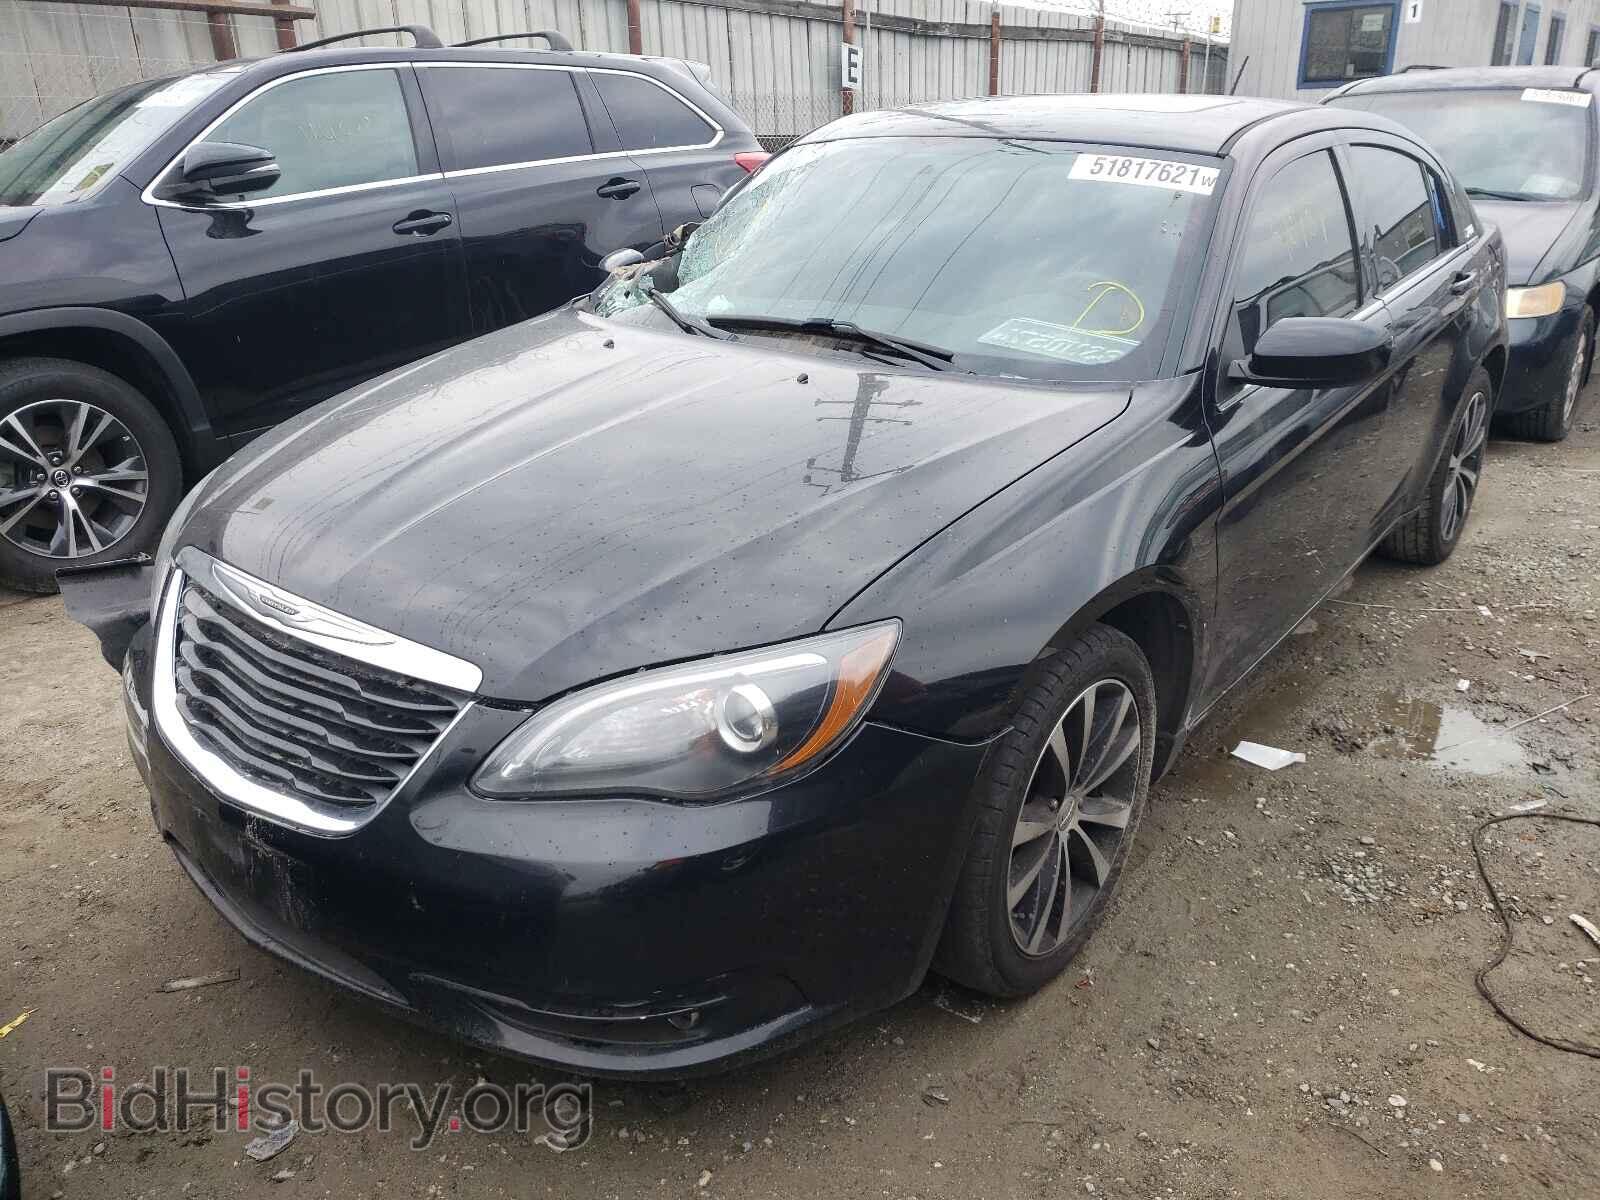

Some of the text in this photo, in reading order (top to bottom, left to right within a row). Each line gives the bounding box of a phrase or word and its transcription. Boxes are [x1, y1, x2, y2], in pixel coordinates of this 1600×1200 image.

[1411, 3, 1419, 18] 1
[847, 47, 859, 84] E
[1089, 156, 1200, 187] 51817621
